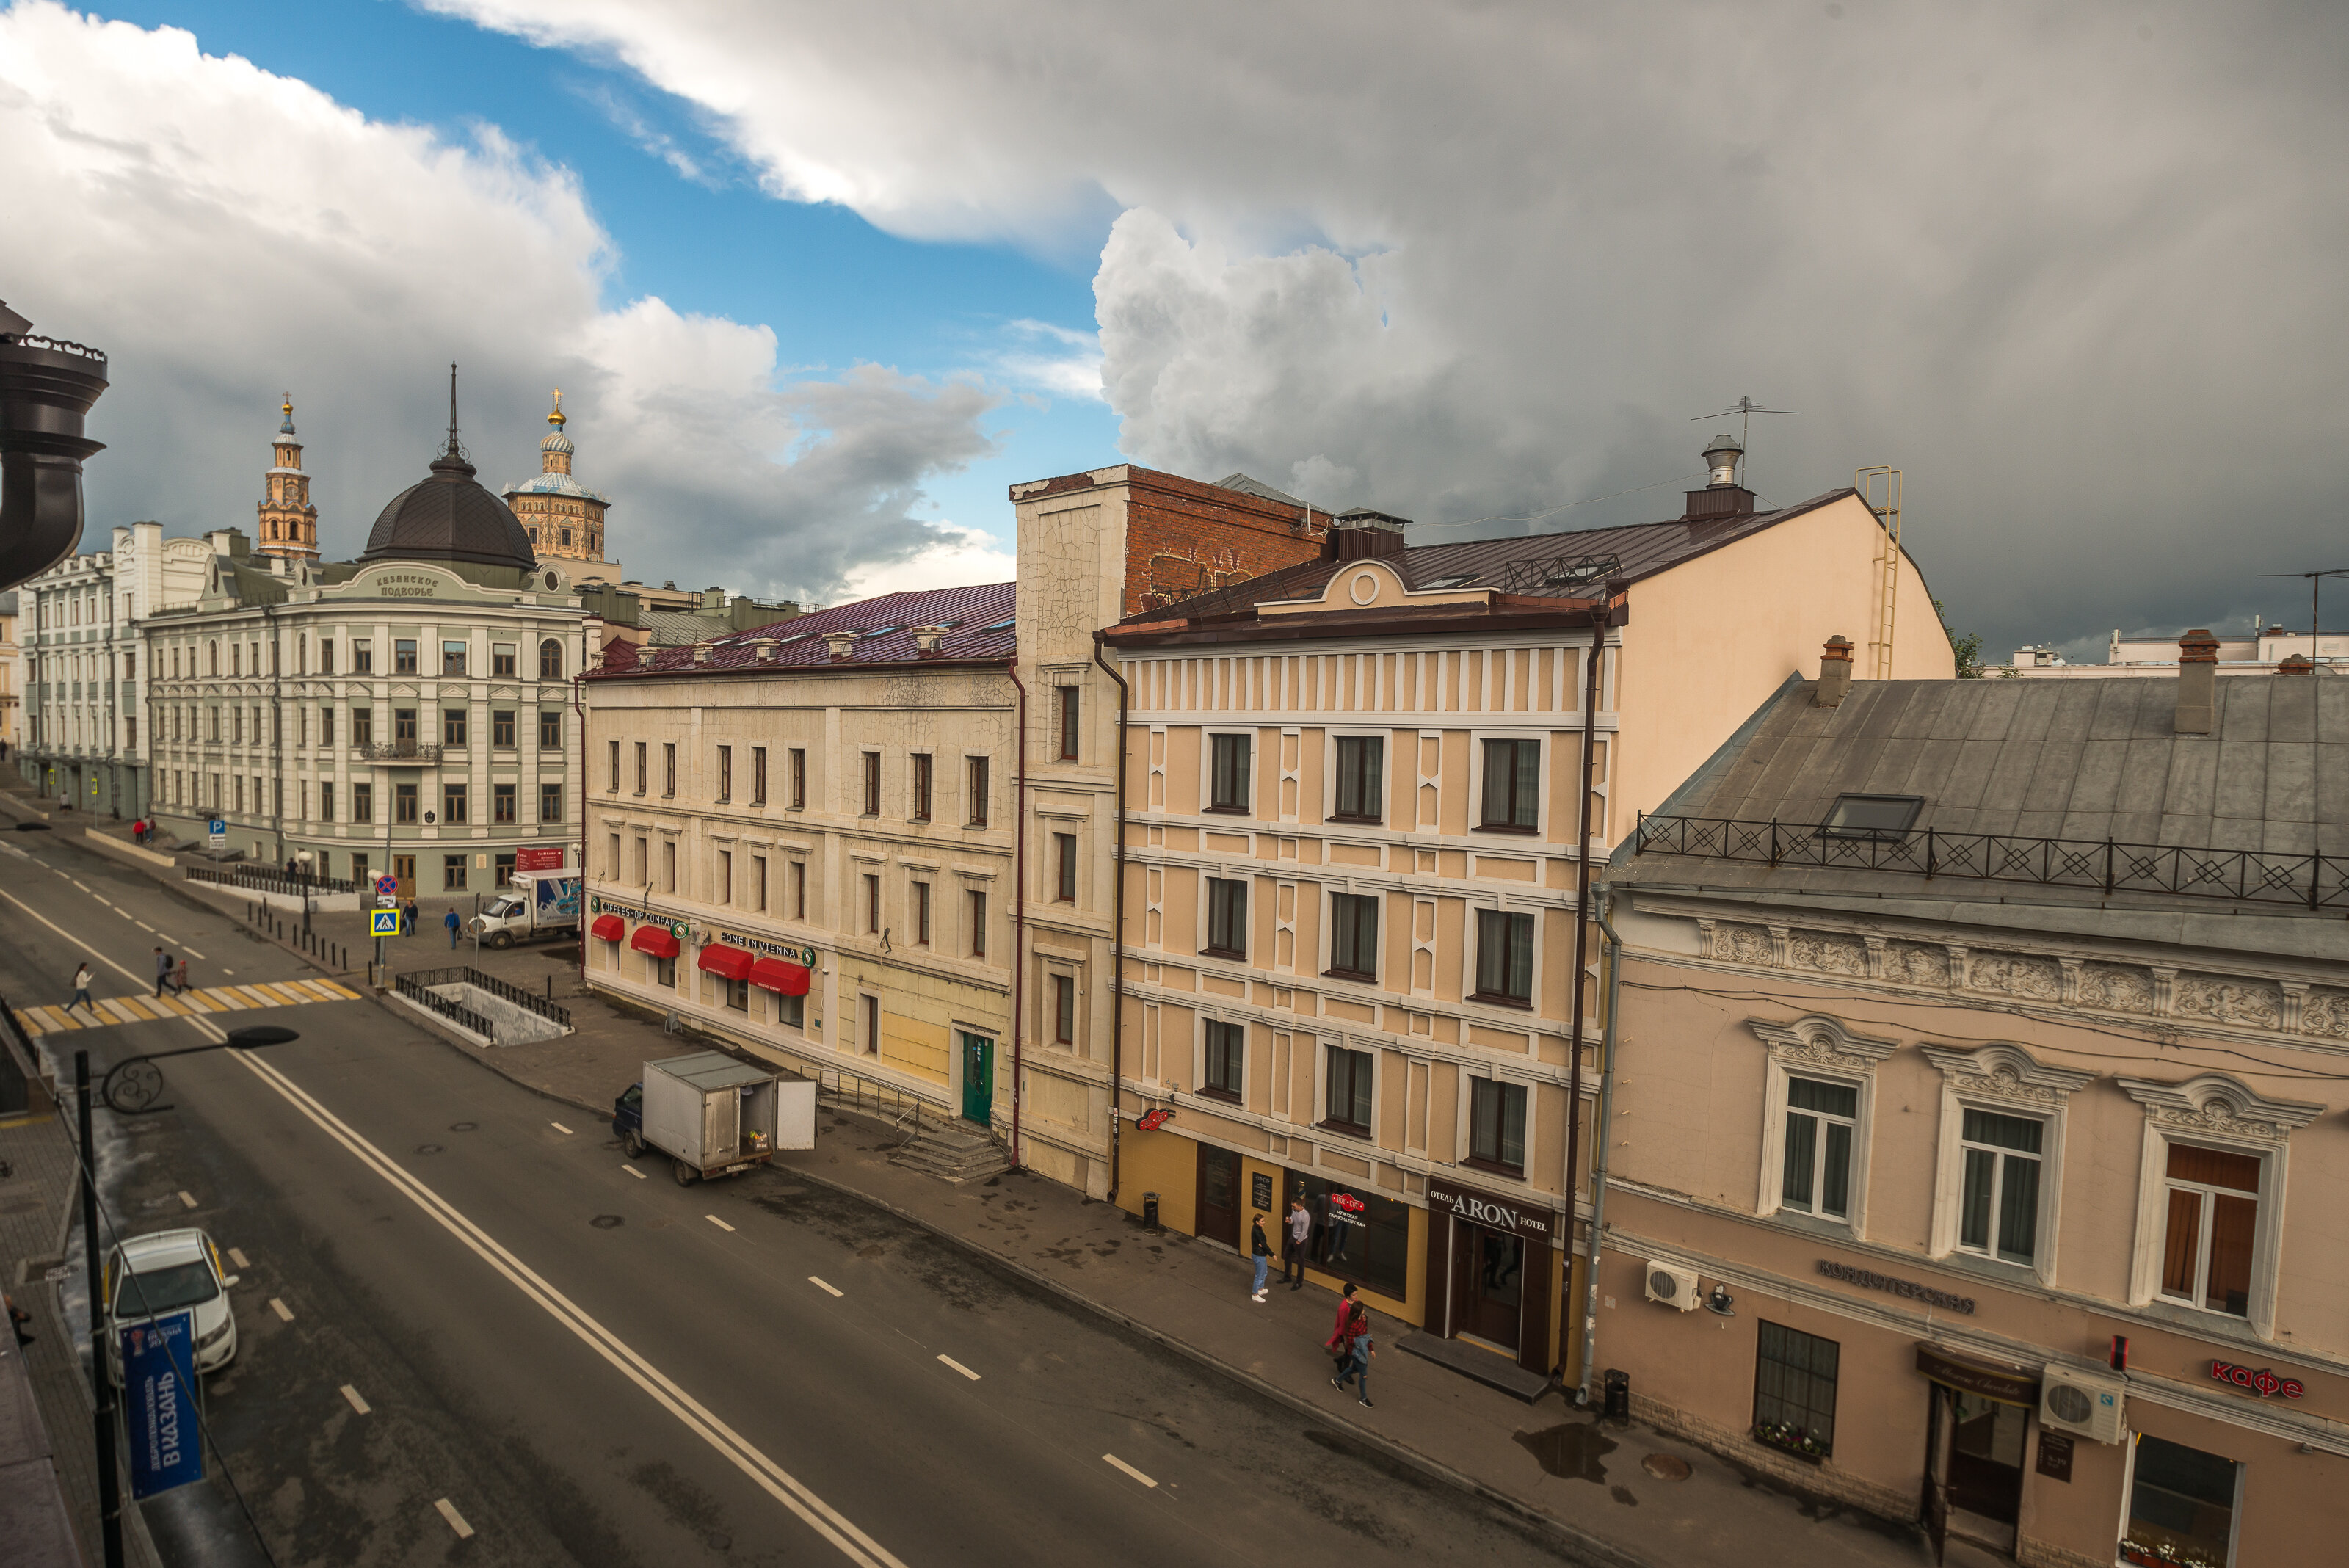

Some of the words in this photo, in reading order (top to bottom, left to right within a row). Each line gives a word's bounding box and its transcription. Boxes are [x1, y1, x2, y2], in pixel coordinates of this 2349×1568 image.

[376, 575, 439, 587] КАЗАНСКОЕ
[381, 587, 434, 598] ПОДВОРЬЕ
[602, 902, 644, 919] COFFEESHOP
[646, 912, 678, 927] COMPAN
[721, 932, 744, 946] HOME
[747, 939, 757, 949] IN
[760, 942, 796, 959] VIENNA
[1336, 1210, 1358, 1220] МУЖСКАЯ
[1431, 1190, 1454, 1204] ОТЕЛЬ
[1451, 1195, 1518, 1230] ARON
[1520, 1216, 1547, 1232] HOTEL
[1819, 1259, 1976, 1315] КОНДИТЕРСКАЯ
[2211, 1362, 2304, 1399] кафе
[157, 1371, 179, 1451] КАЗАНЬ
[163, 1450, 181, 1467] В
